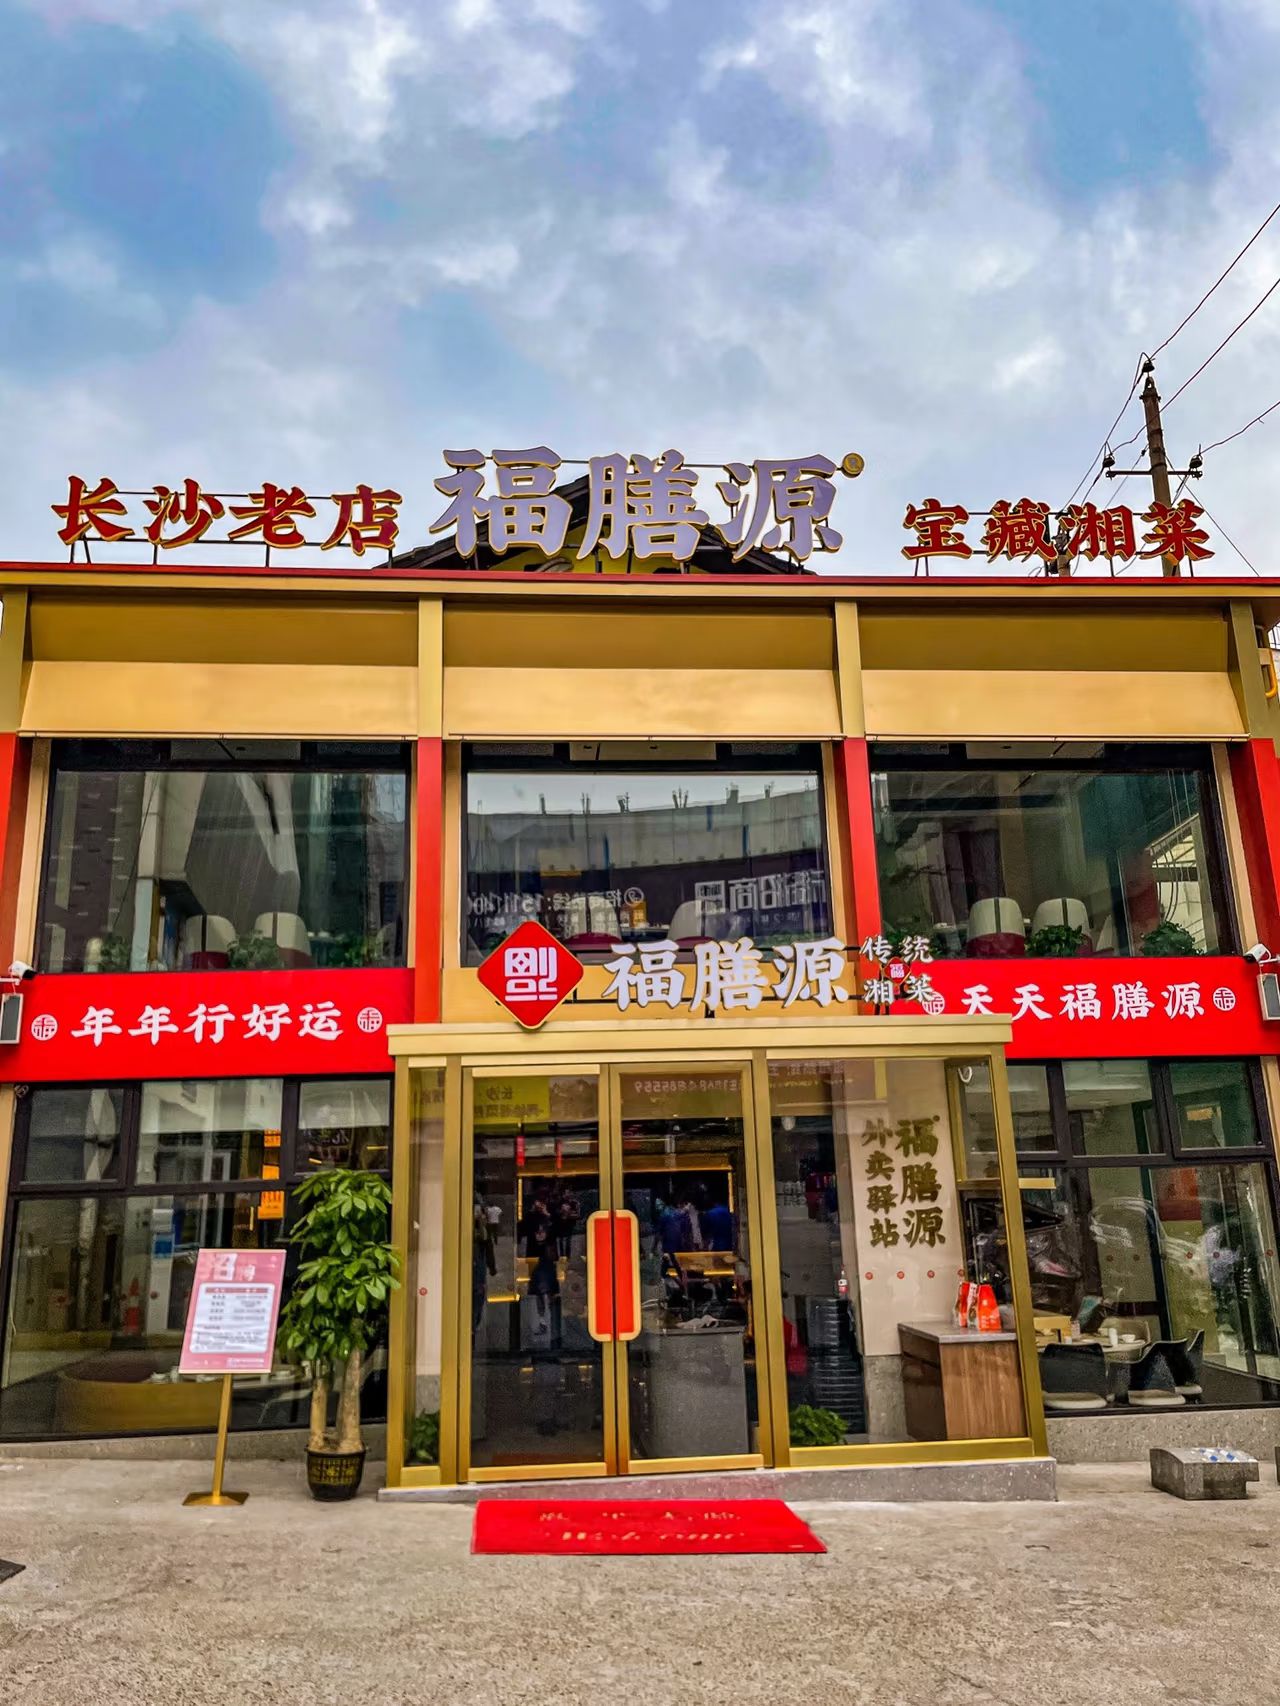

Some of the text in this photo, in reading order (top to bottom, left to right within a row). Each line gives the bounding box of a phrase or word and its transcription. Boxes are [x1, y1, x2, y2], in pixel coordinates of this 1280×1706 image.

[51, 475, 403, 556] 长沙老店
[429, 446, 844, 563] 福膳源
[902, 497, 1215, 565] 宝藏湘菜
[601, 936, 849, 1013] 福膳源
[859, 935, 934, 964] 传统
[71, 1000, 344, 1047] 年年行好运
[863, 974, 935, 1006] 湘菜
[961, 981, 1205, 1021] 天天福膳源
[861, 1118, 900, 1249] 外卖驿站
[894, 1114, 946, 1249] 福膳源
